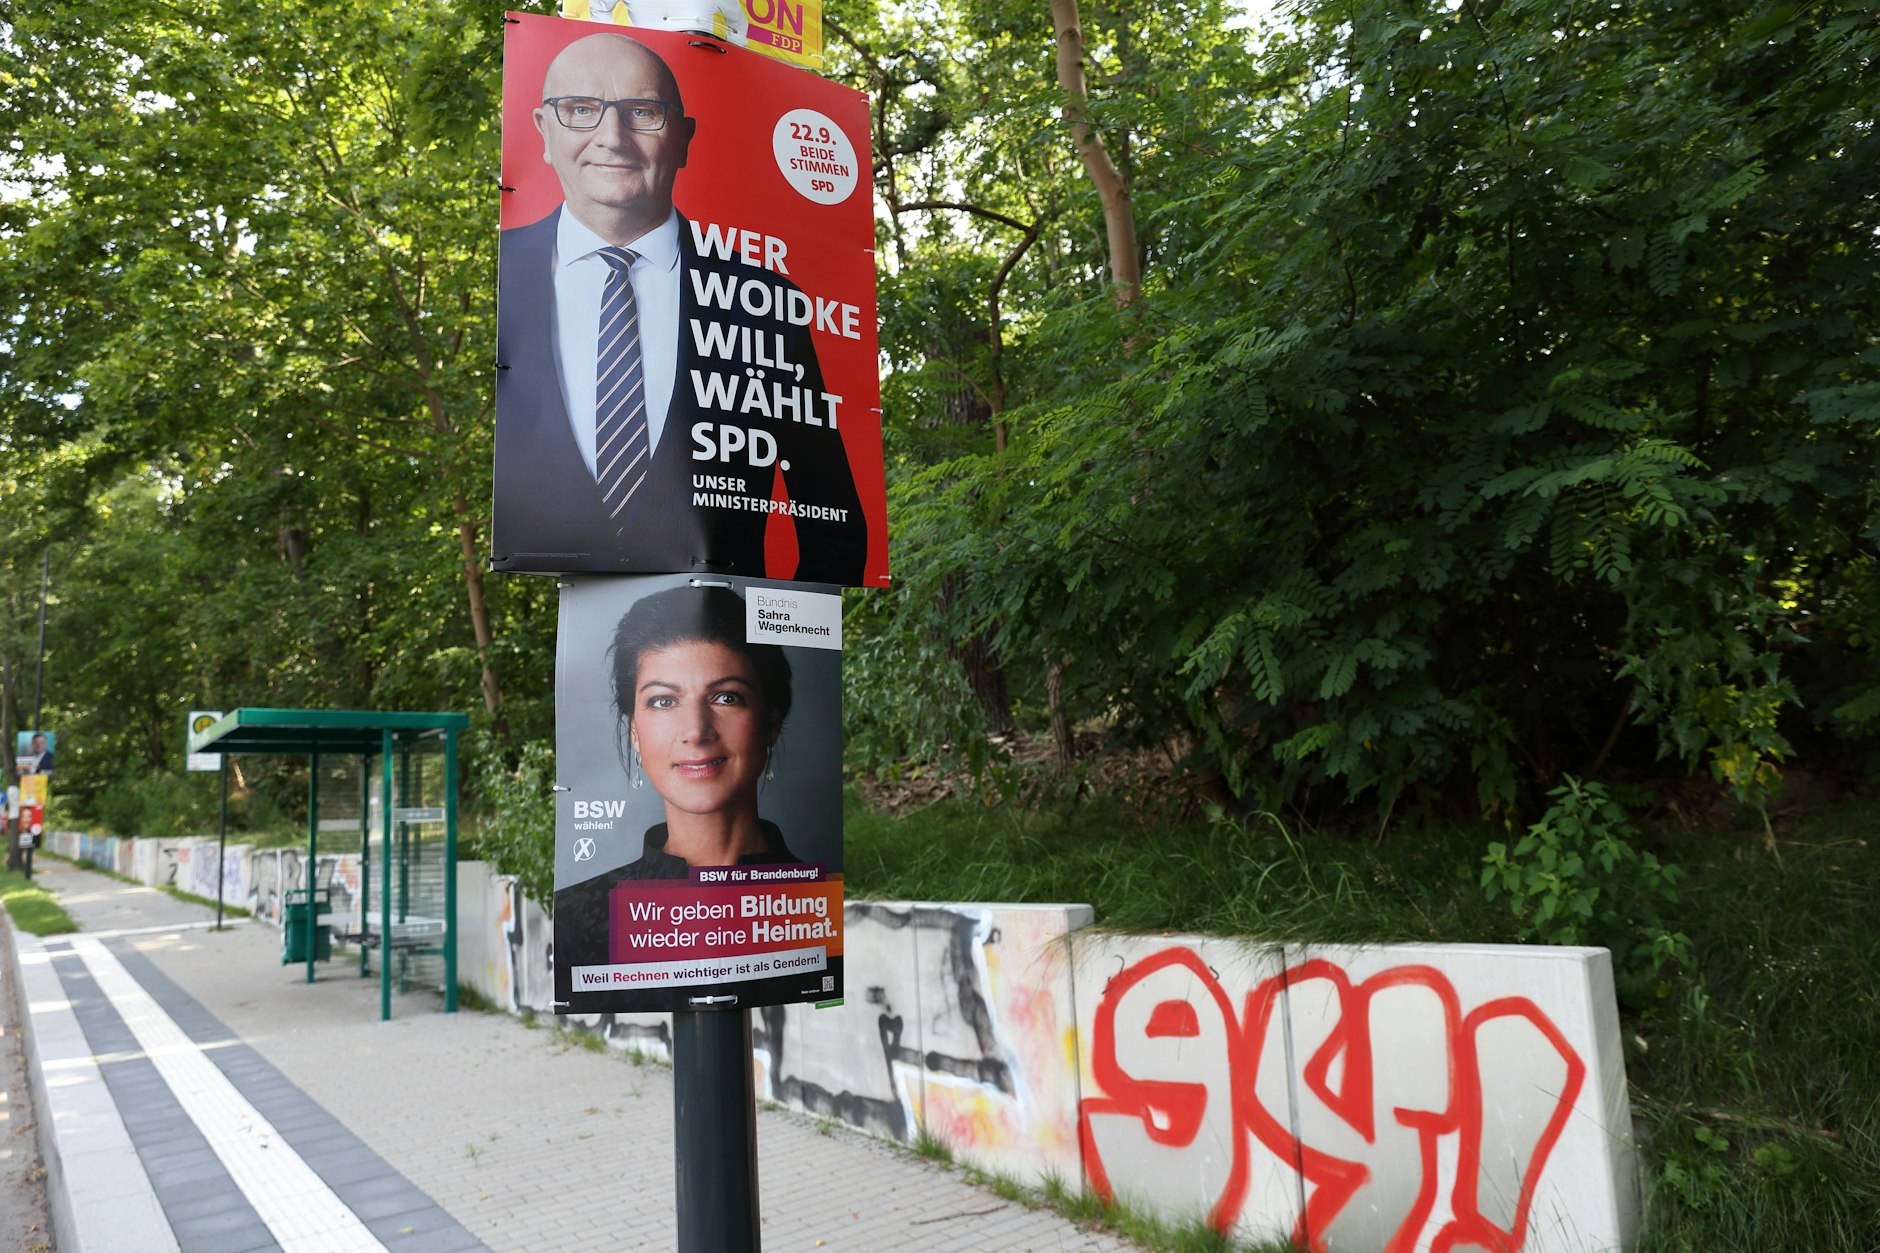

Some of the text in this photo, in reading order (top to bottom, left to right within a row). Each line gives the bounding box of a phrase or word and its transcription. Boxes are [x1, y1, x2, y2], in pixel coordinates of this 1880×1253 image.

[771, 33, 801, 51] FDP
[790, 122, 836, 145] 22.9.
[800, 145, 835, 161] BEIDE
[789, 158, 849, 177] STIMMEN
[811, 179, 834, 193] SPD
[689, 219, 789, 275] WER
[689, 268, 861, 340] WOIDKE
[689, 318, 805, 382] WILL,
[689, 367, 843, 430] WÄHLT
[691, 421, 791, 472] SPD.
[692, 474, 747, 493] UNSER
[692, 492, 848, 523] MINISTERPRÄSIDENT
[757, 595, 798, 609] Bündnis
[757, 609, 790, 621] Sahra
[758, 620, 830, 636] Wagenknecht
[574, 800, 626, 819] BSW
[574, 821, 613, 830] wählen!
[699, 867, 819, 882] BSW für Brandenburg!
[629, 893, 828, 925] Wir geben Bildung
[629, 917, 838, 948] wieder eine Heimat.
[582, 954, 820, 984] Weil Rechnen wichtiger ist als Gendern!
